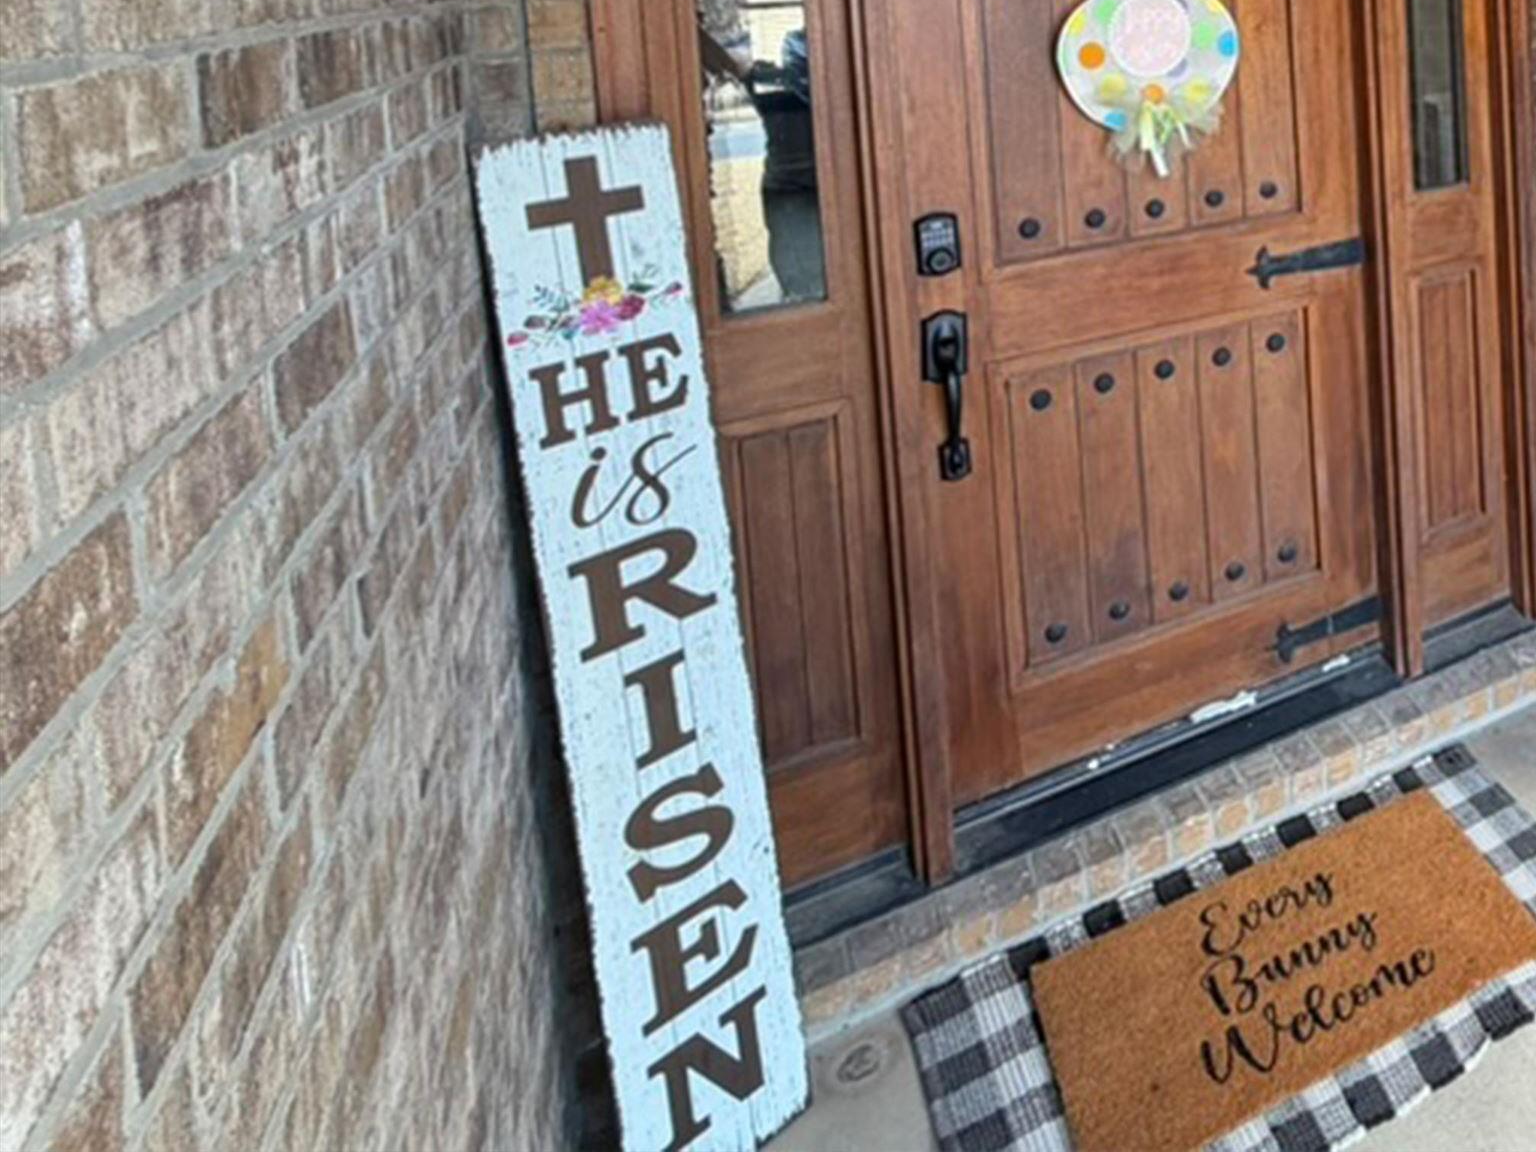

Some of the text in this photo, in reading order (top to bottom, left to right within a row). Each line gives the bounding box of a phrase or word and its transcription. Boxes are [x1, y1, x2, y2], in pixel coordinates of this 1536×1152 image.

[528, 333, 690, 451] HE
[570, 431, 698, 530] is
[566, 527, 767, 1152] RISEN
[1200, 872, 1335, 956] Every
[1201, 911, 1378, 1016] Bunny
[1201, 947, 1436, 1084] Welcome
